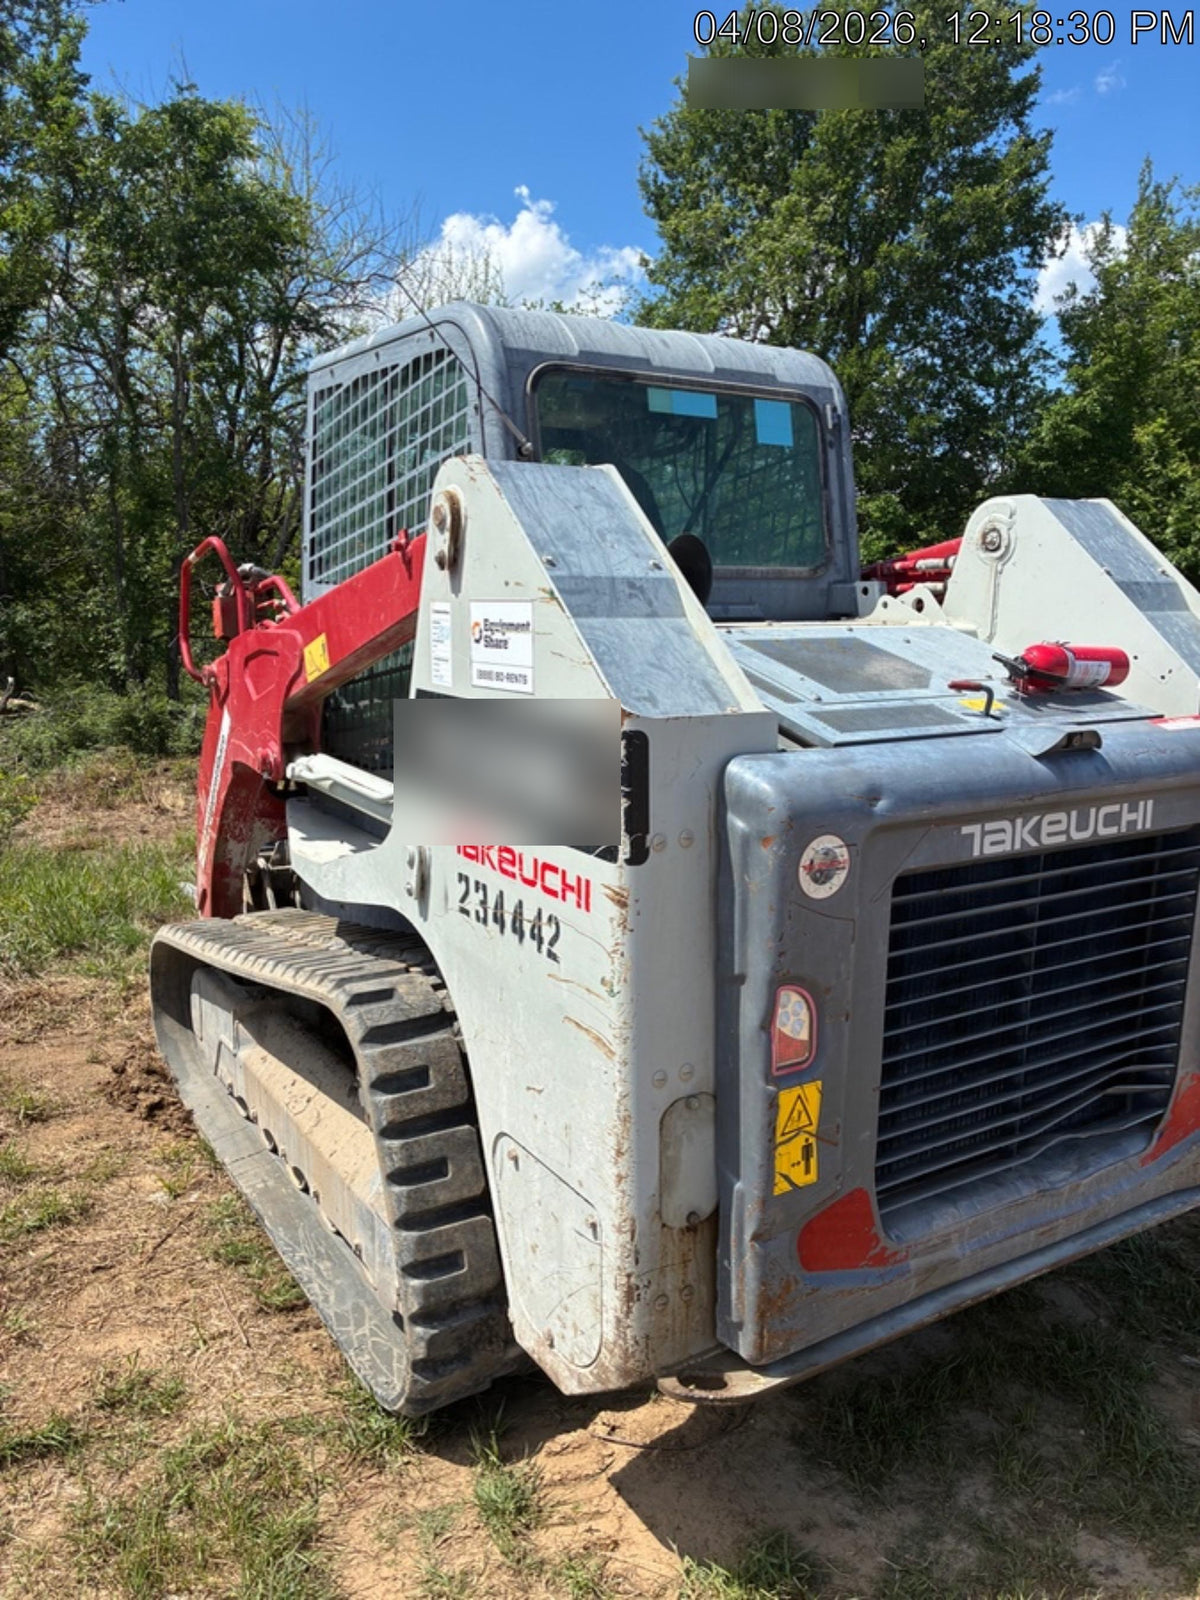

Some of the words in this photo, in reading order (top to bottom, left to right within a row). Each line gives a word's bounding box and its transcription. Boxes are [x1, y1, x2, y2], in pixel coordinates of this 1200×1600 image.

[483, 618, 531, 636] Equipment
[483, 634, 509, 650] Share
[457, 872, 561, 965] 234442
